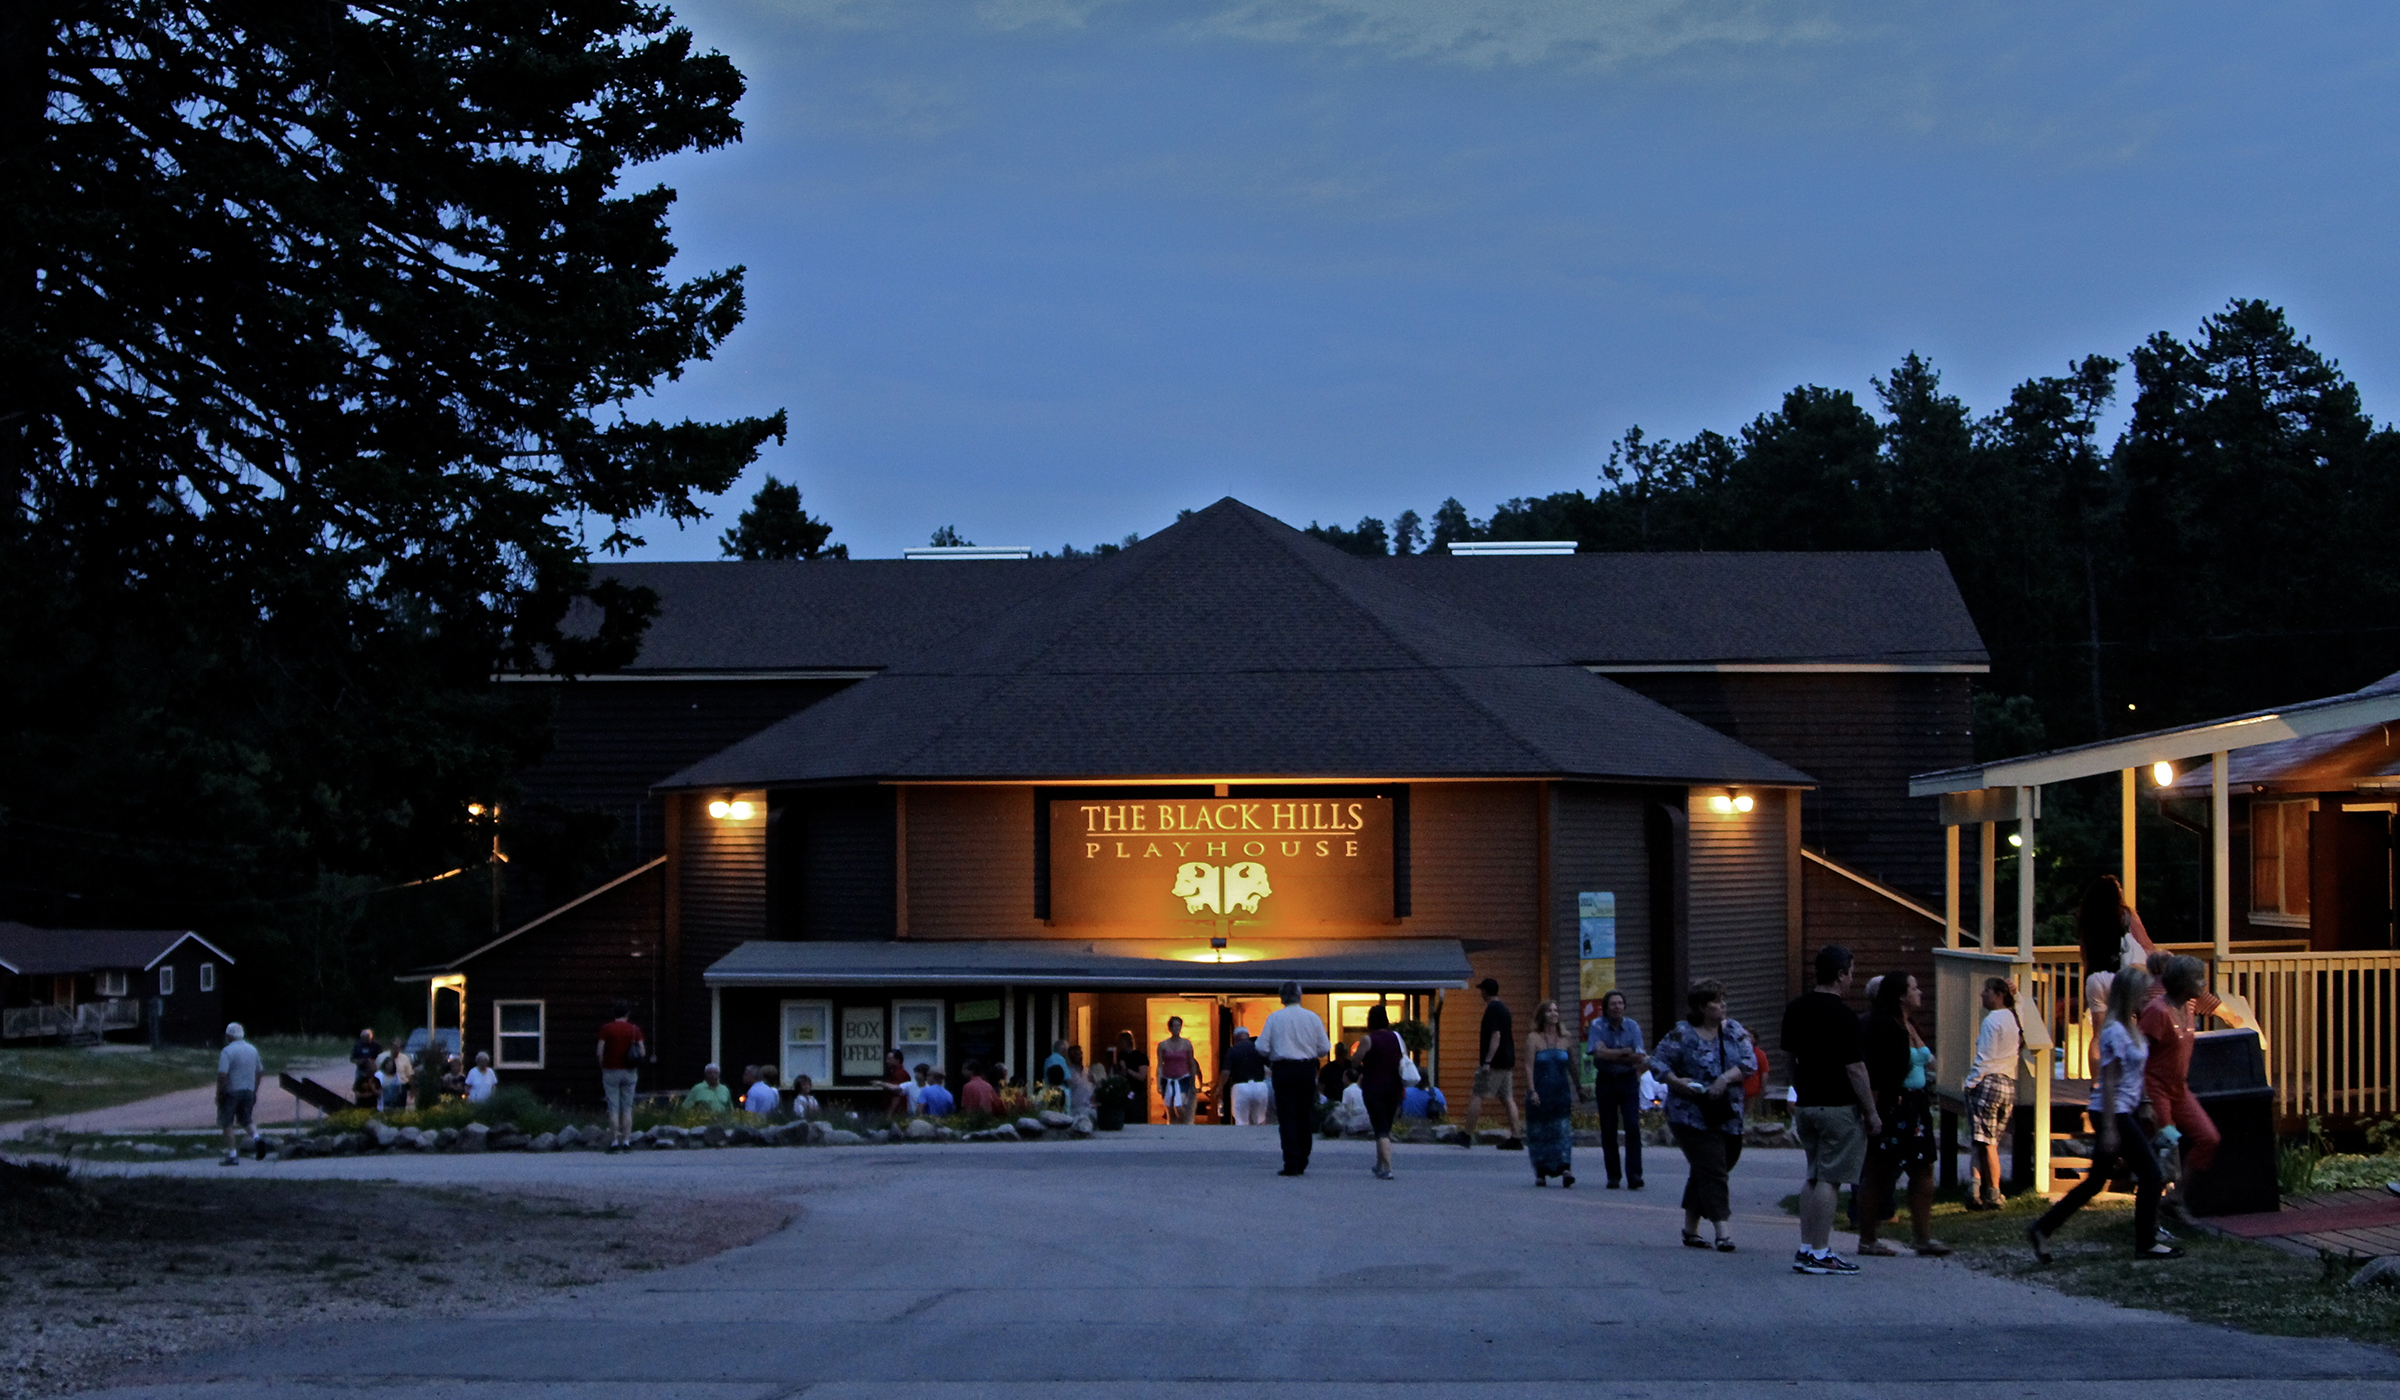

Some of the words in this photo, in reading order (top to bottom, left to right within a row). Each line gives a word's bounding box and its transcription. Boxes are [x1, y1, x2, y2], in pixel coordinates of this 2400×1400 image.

[1080, 805, 1146, 832] THE
[1158, 803, 1262, 831] BLACK
[1272, 803, 1364, 831] HILLS
[1086, 840, 1358, 858] PLAYHOUSE
[845, 1021, 880, 1039] BOX
[842, 1044, 881, 1061] OFFICE
